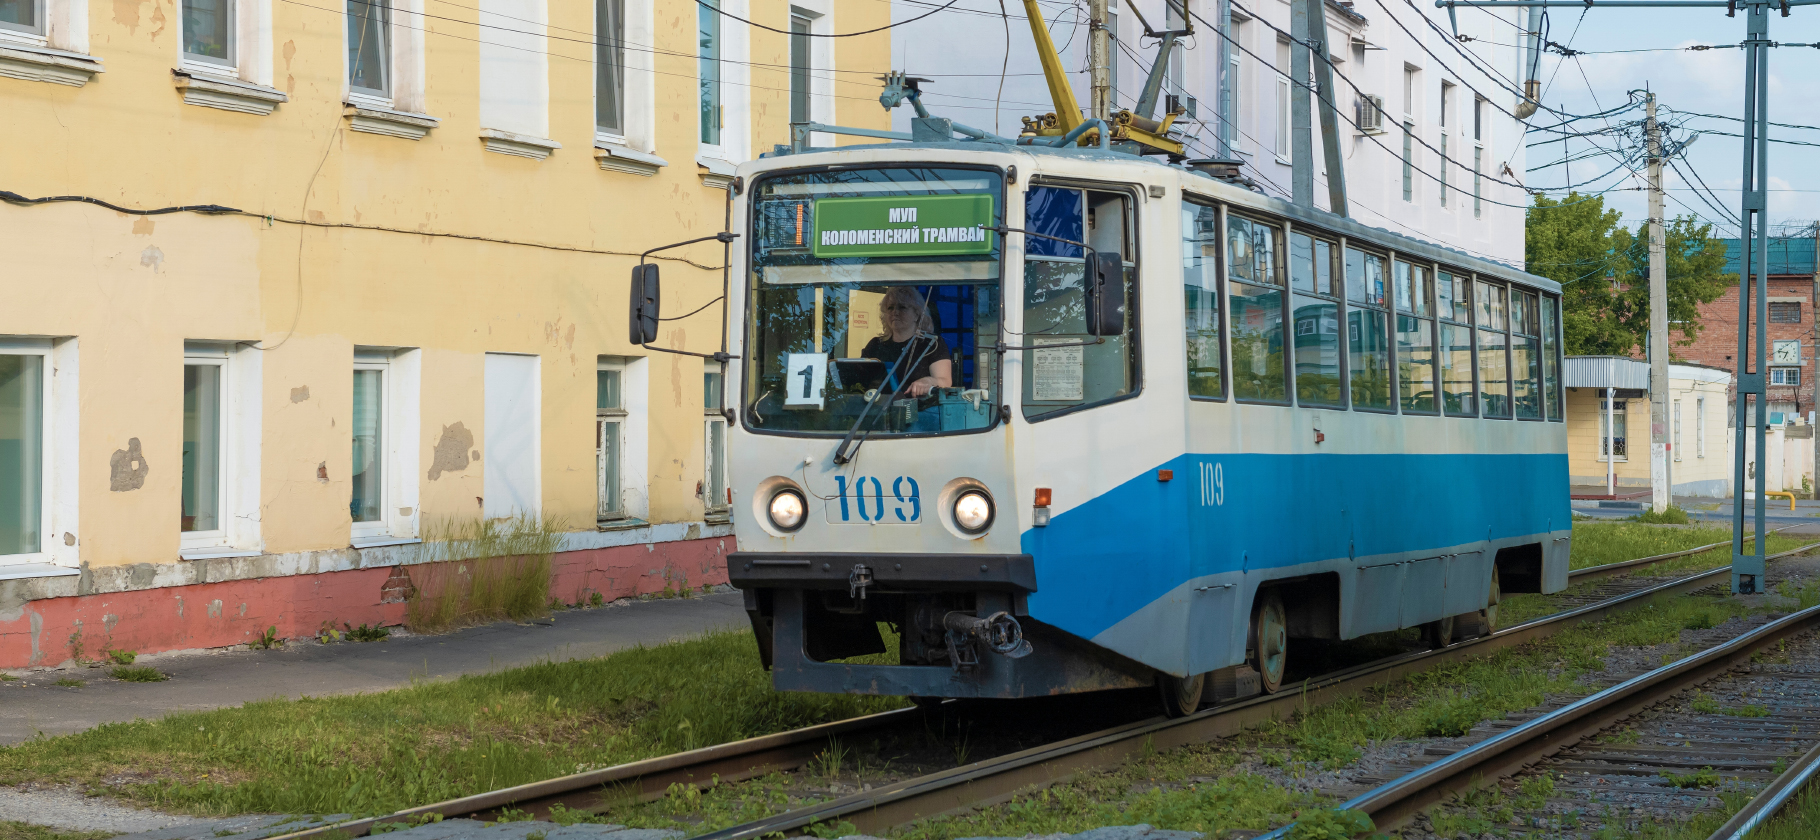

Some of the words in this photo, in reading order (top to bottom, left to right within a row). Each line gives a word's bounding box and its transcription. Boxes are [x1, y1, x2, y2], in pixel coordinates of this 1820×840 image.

[888, 207, 918, 223] МУП
[821, 225, 920, 246] КОЛОМЕНСКИЙ
[921, 223, 985, 243] ТРАМВАЙ
[797, 365, 814, 399] 1
[834, 475, 921, 522] 109
[1199, 461, 1224, 507] 109
